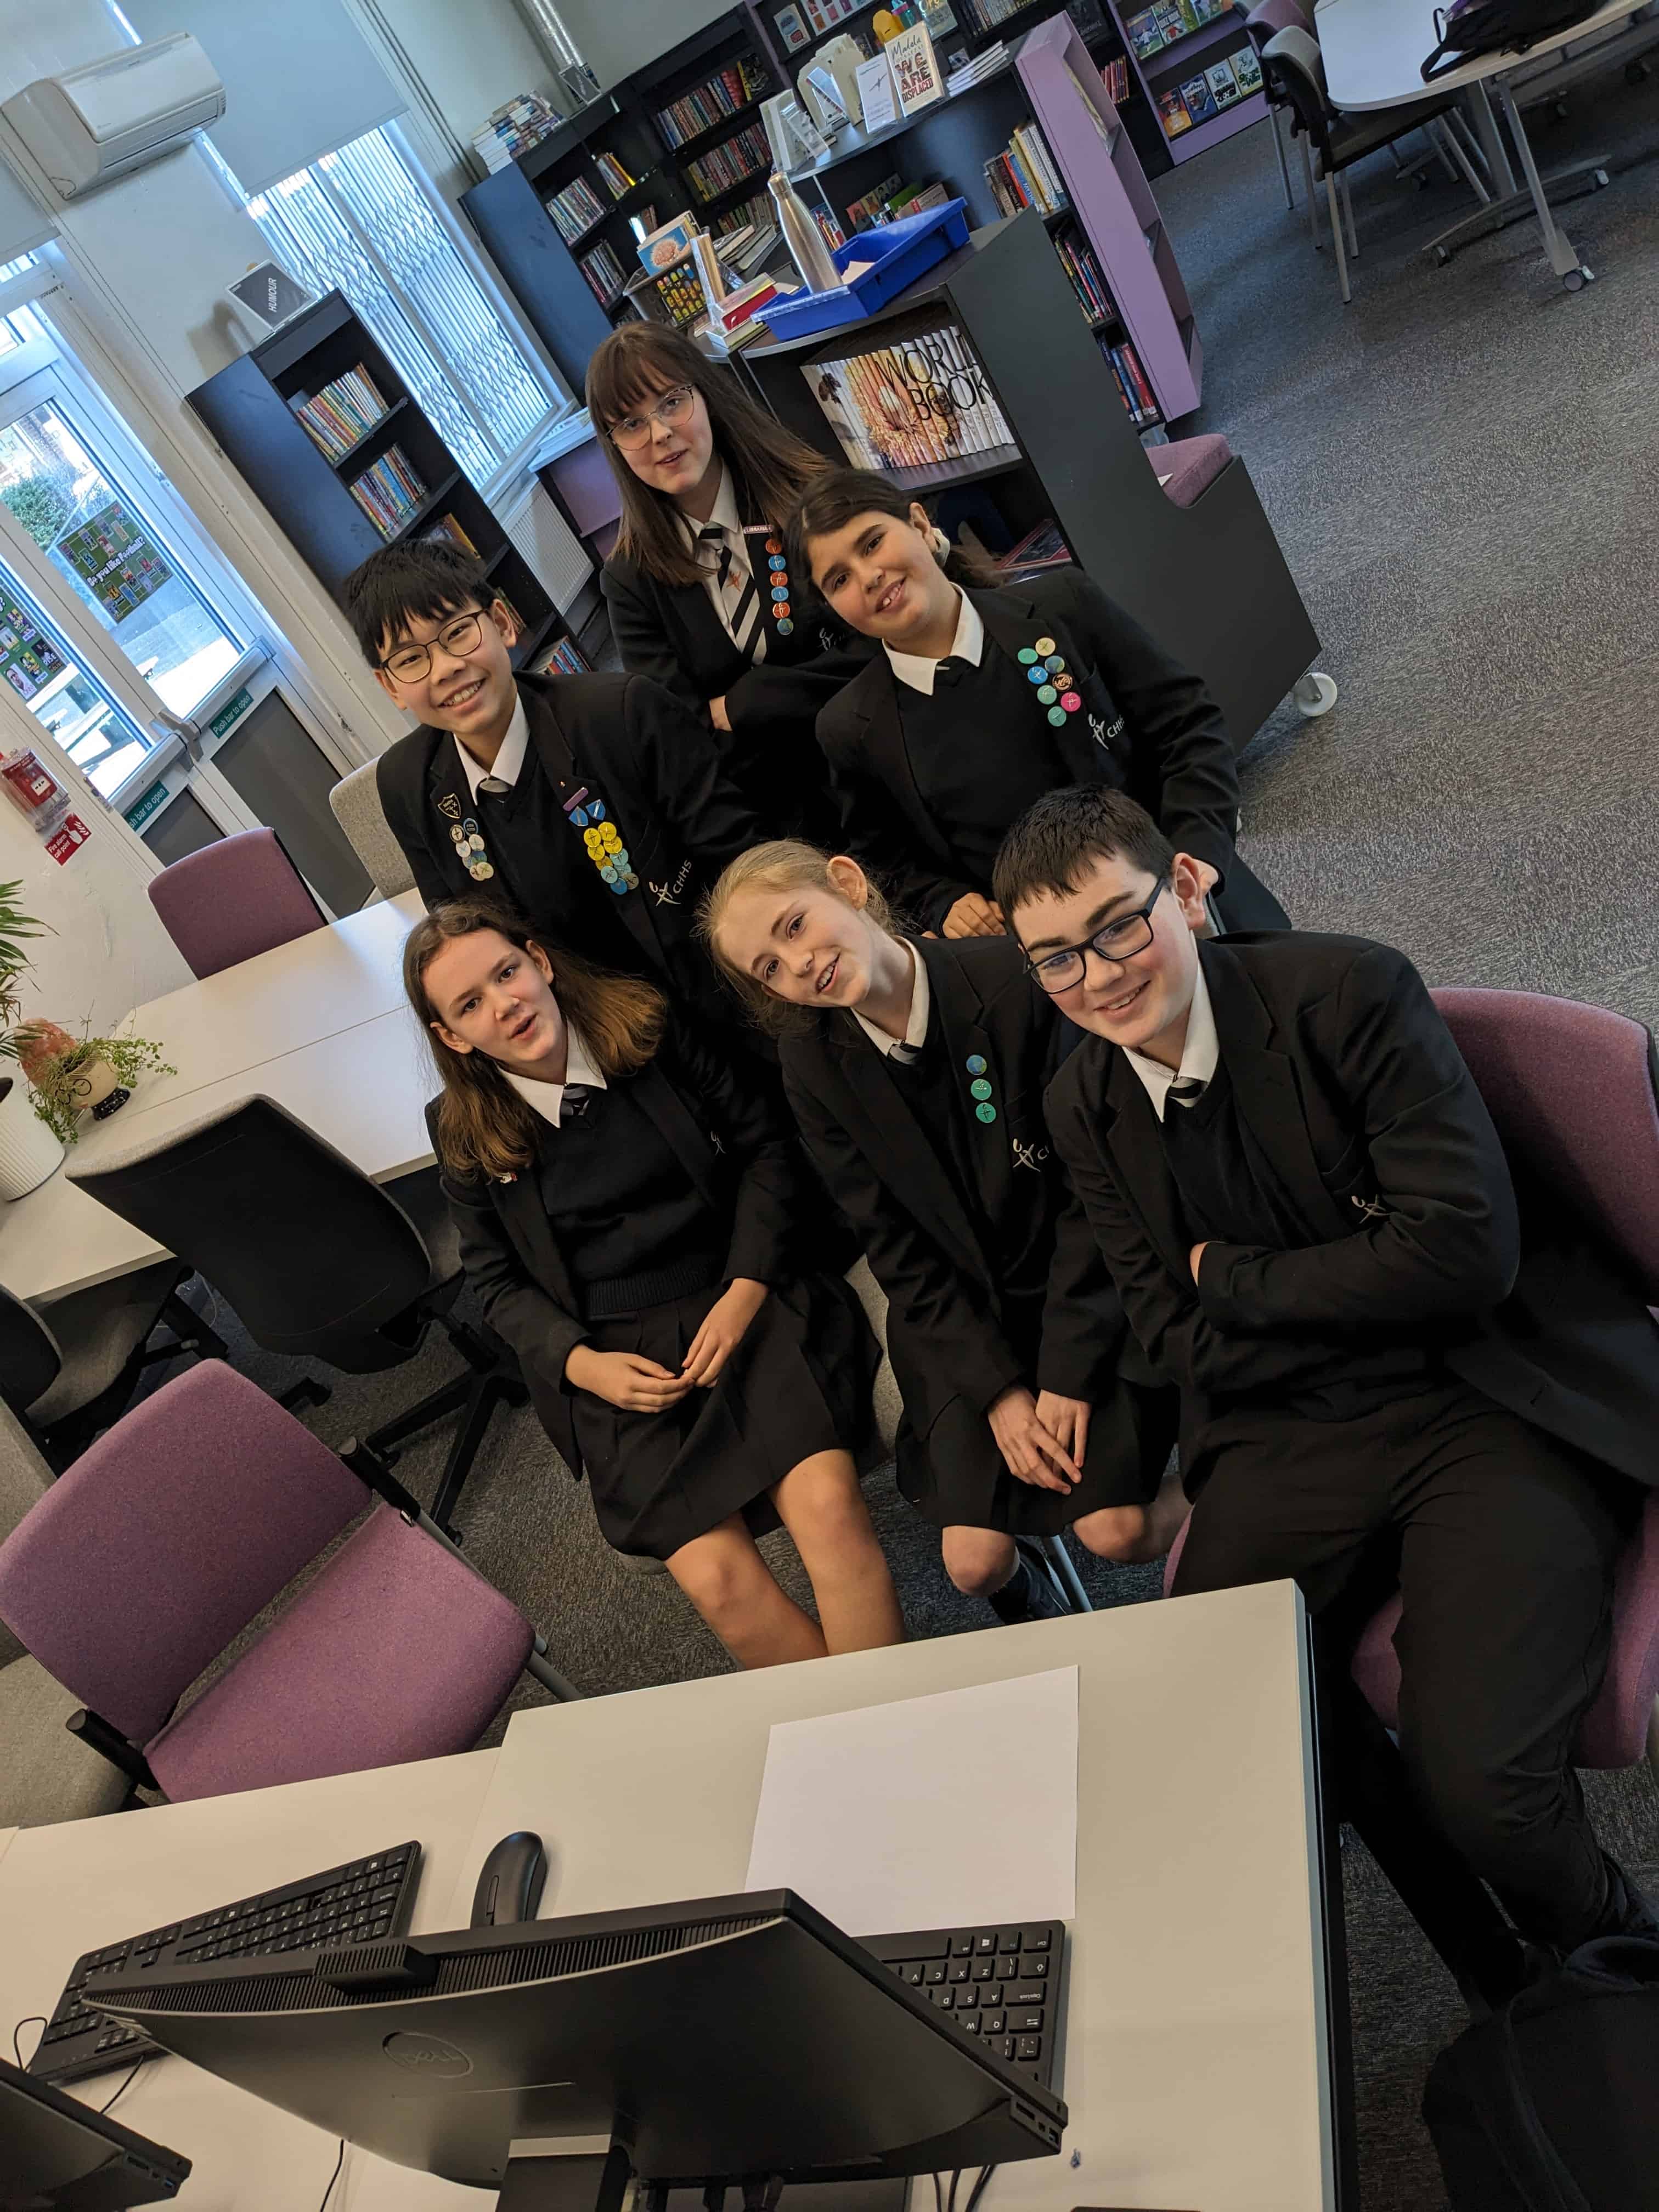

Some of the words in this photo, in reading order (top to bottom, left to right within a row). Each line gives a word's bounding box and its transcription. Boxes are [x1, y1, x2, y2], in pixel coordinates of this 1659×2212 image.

[891, 35, 922, 59] Malala
[895, 52, 927, 78] WE
[901, 65, 932, 92] ARE
[902, 78, 934, 103] DISPLACED
[268, 278, 277, 312] HUMOUR
[909, 369, 995, 421] BOOK
[97, 565, 110, 582] you
[106, 557, 122, 572] like
[117, 536, 145, 562] Football?
[213, 719, 227, 735] Push
[226, 712, 235, 725] bar
[233, 705, 240, 715] to
[238, 695, 251, 710] open
[137, 806, 146, 821] bar
[144, 801, 153, 812] to
[151, 788, 166, 805] open
[48, 844, 58, 853] Fire
[57, 834, 67, 846] alarm
[60, 841, 71, 853] point
[673, 860, 692, 894] CHHS
